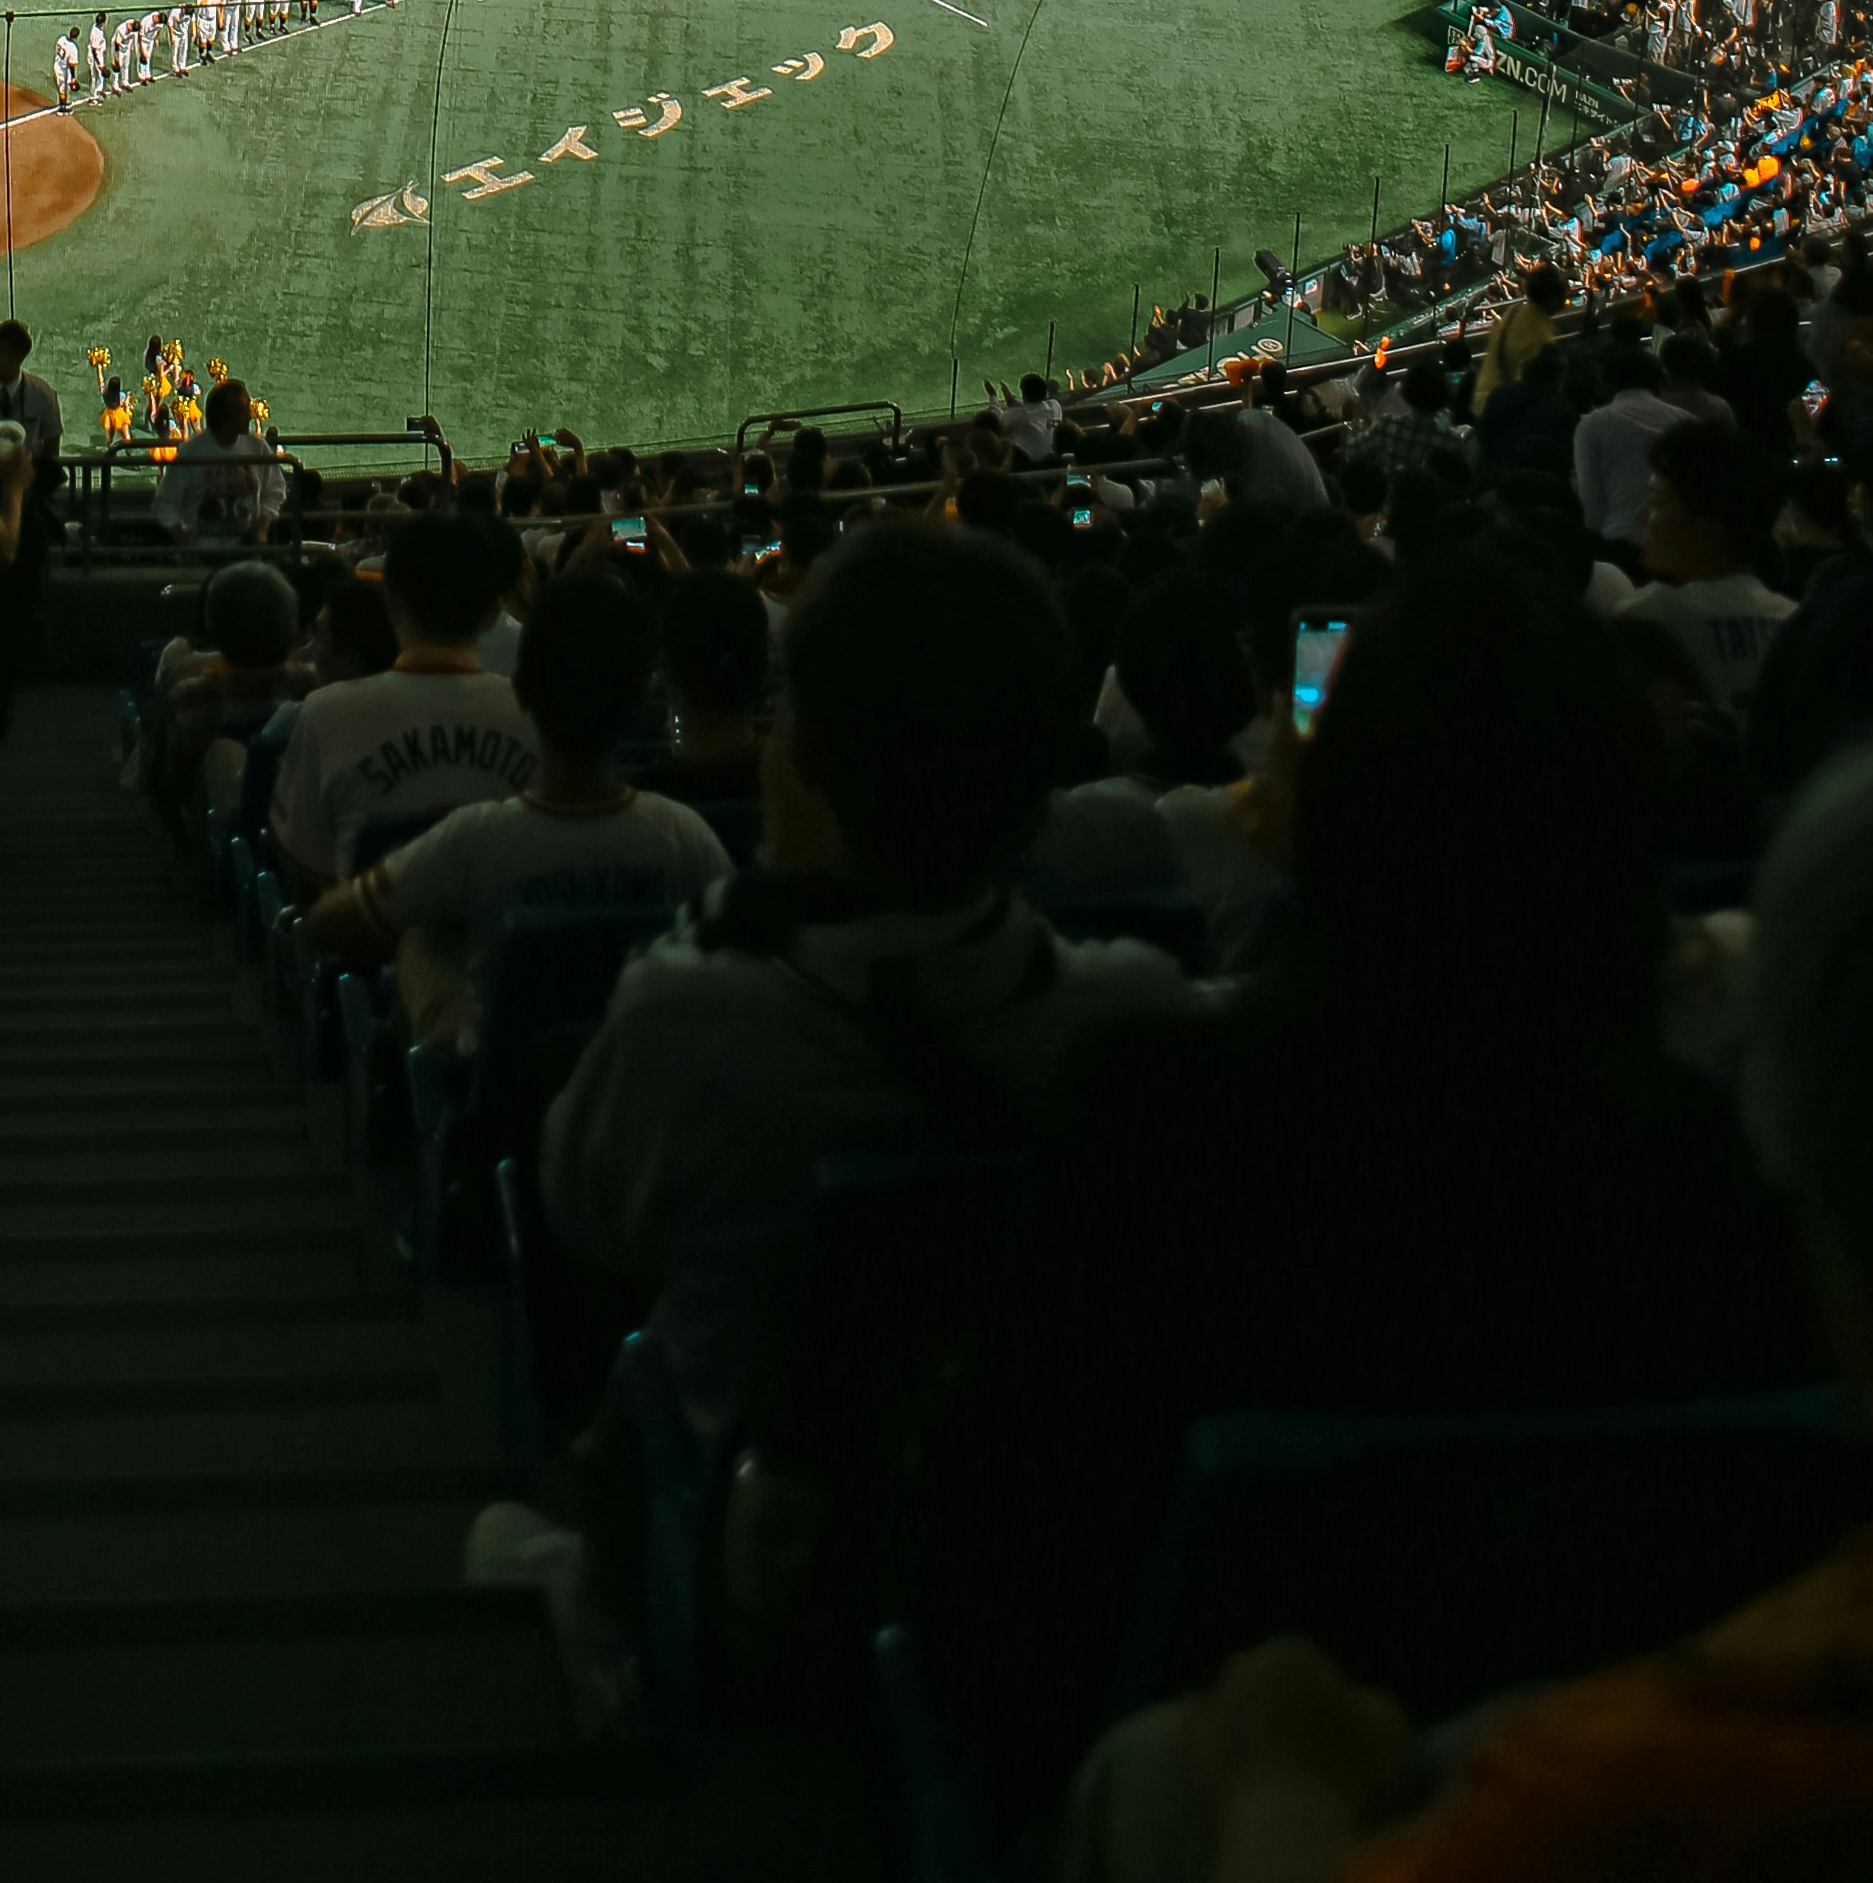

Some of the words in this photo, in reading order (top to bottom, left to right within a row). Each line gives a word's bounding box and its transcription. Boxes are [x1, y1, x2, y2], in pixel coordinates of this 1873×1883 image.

[440, 21, 895, 200] エイジェック
[358, 725, 539, 794] SAKAMOTO
